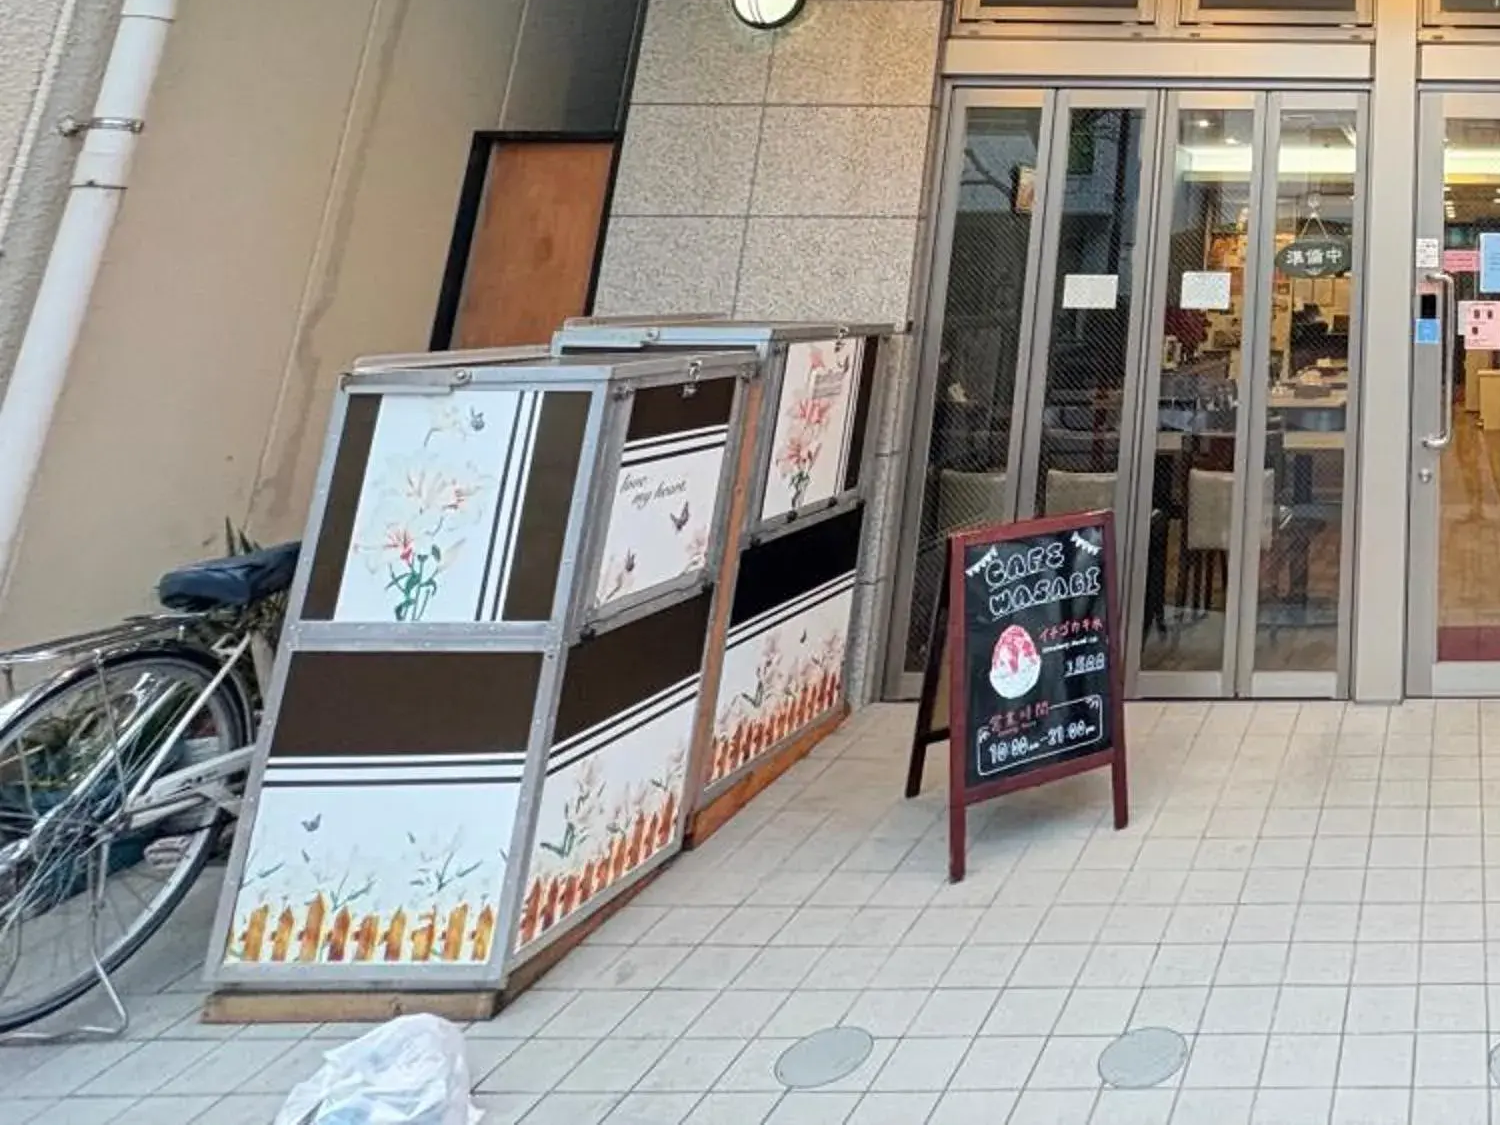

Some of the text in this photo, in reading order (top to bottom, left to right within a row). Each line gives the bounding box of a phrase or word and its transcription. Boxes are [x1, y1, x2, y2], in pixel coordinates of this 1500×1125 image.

[1286, 247, 1342, 266] 準備中
[985, 542, 1065, 588] CAFE
[989, 566, 1101, 617] WASABI
